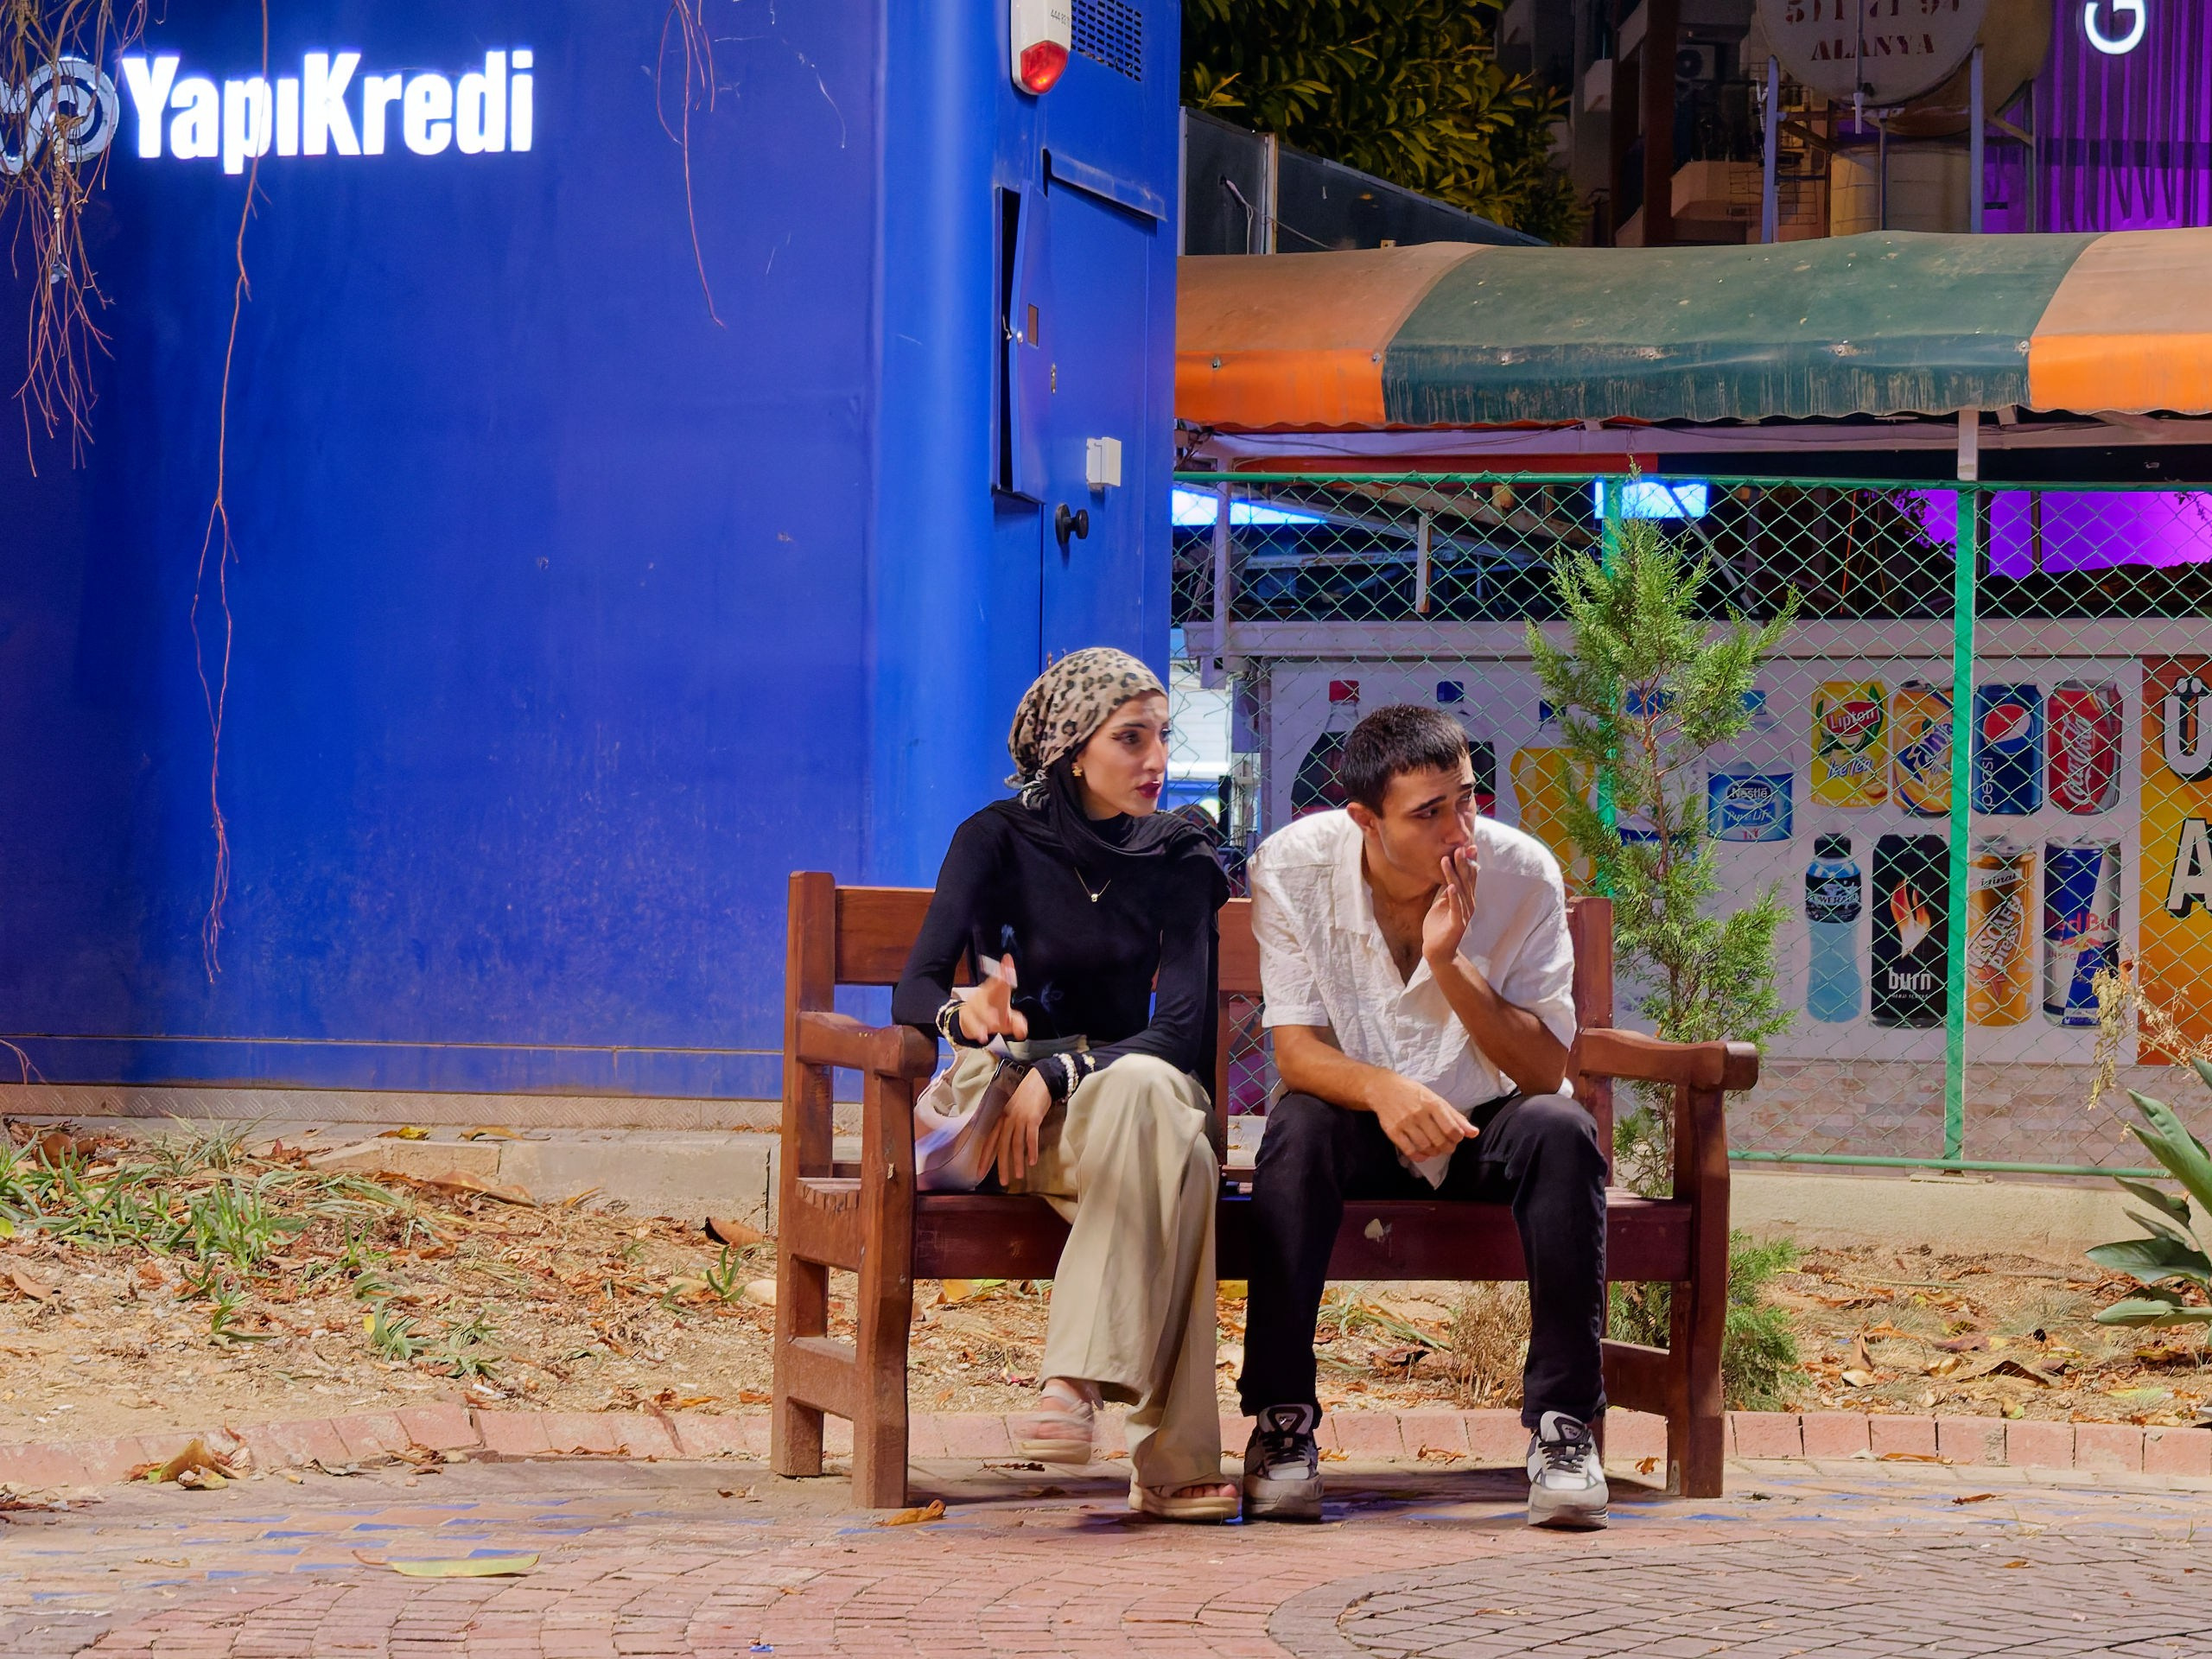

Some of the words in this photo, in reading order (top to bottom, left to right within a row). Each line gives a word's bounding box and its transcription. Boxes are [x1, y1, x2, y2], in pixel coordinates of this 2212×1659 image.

[1811, 34, 1935, 60] ALANYA
[1830, 708, 1875, 730] Lipton
[1827, 760, 1848, 779] Ice
[1850, 755, 1872, 776] Tea
[1731, 786, 1769, 800] Nestlé
[1981, 756, 1994, 808] pepsi
[1728, 810, 1751, 822] Pur
[1887, 966, 1931, 991] burn
